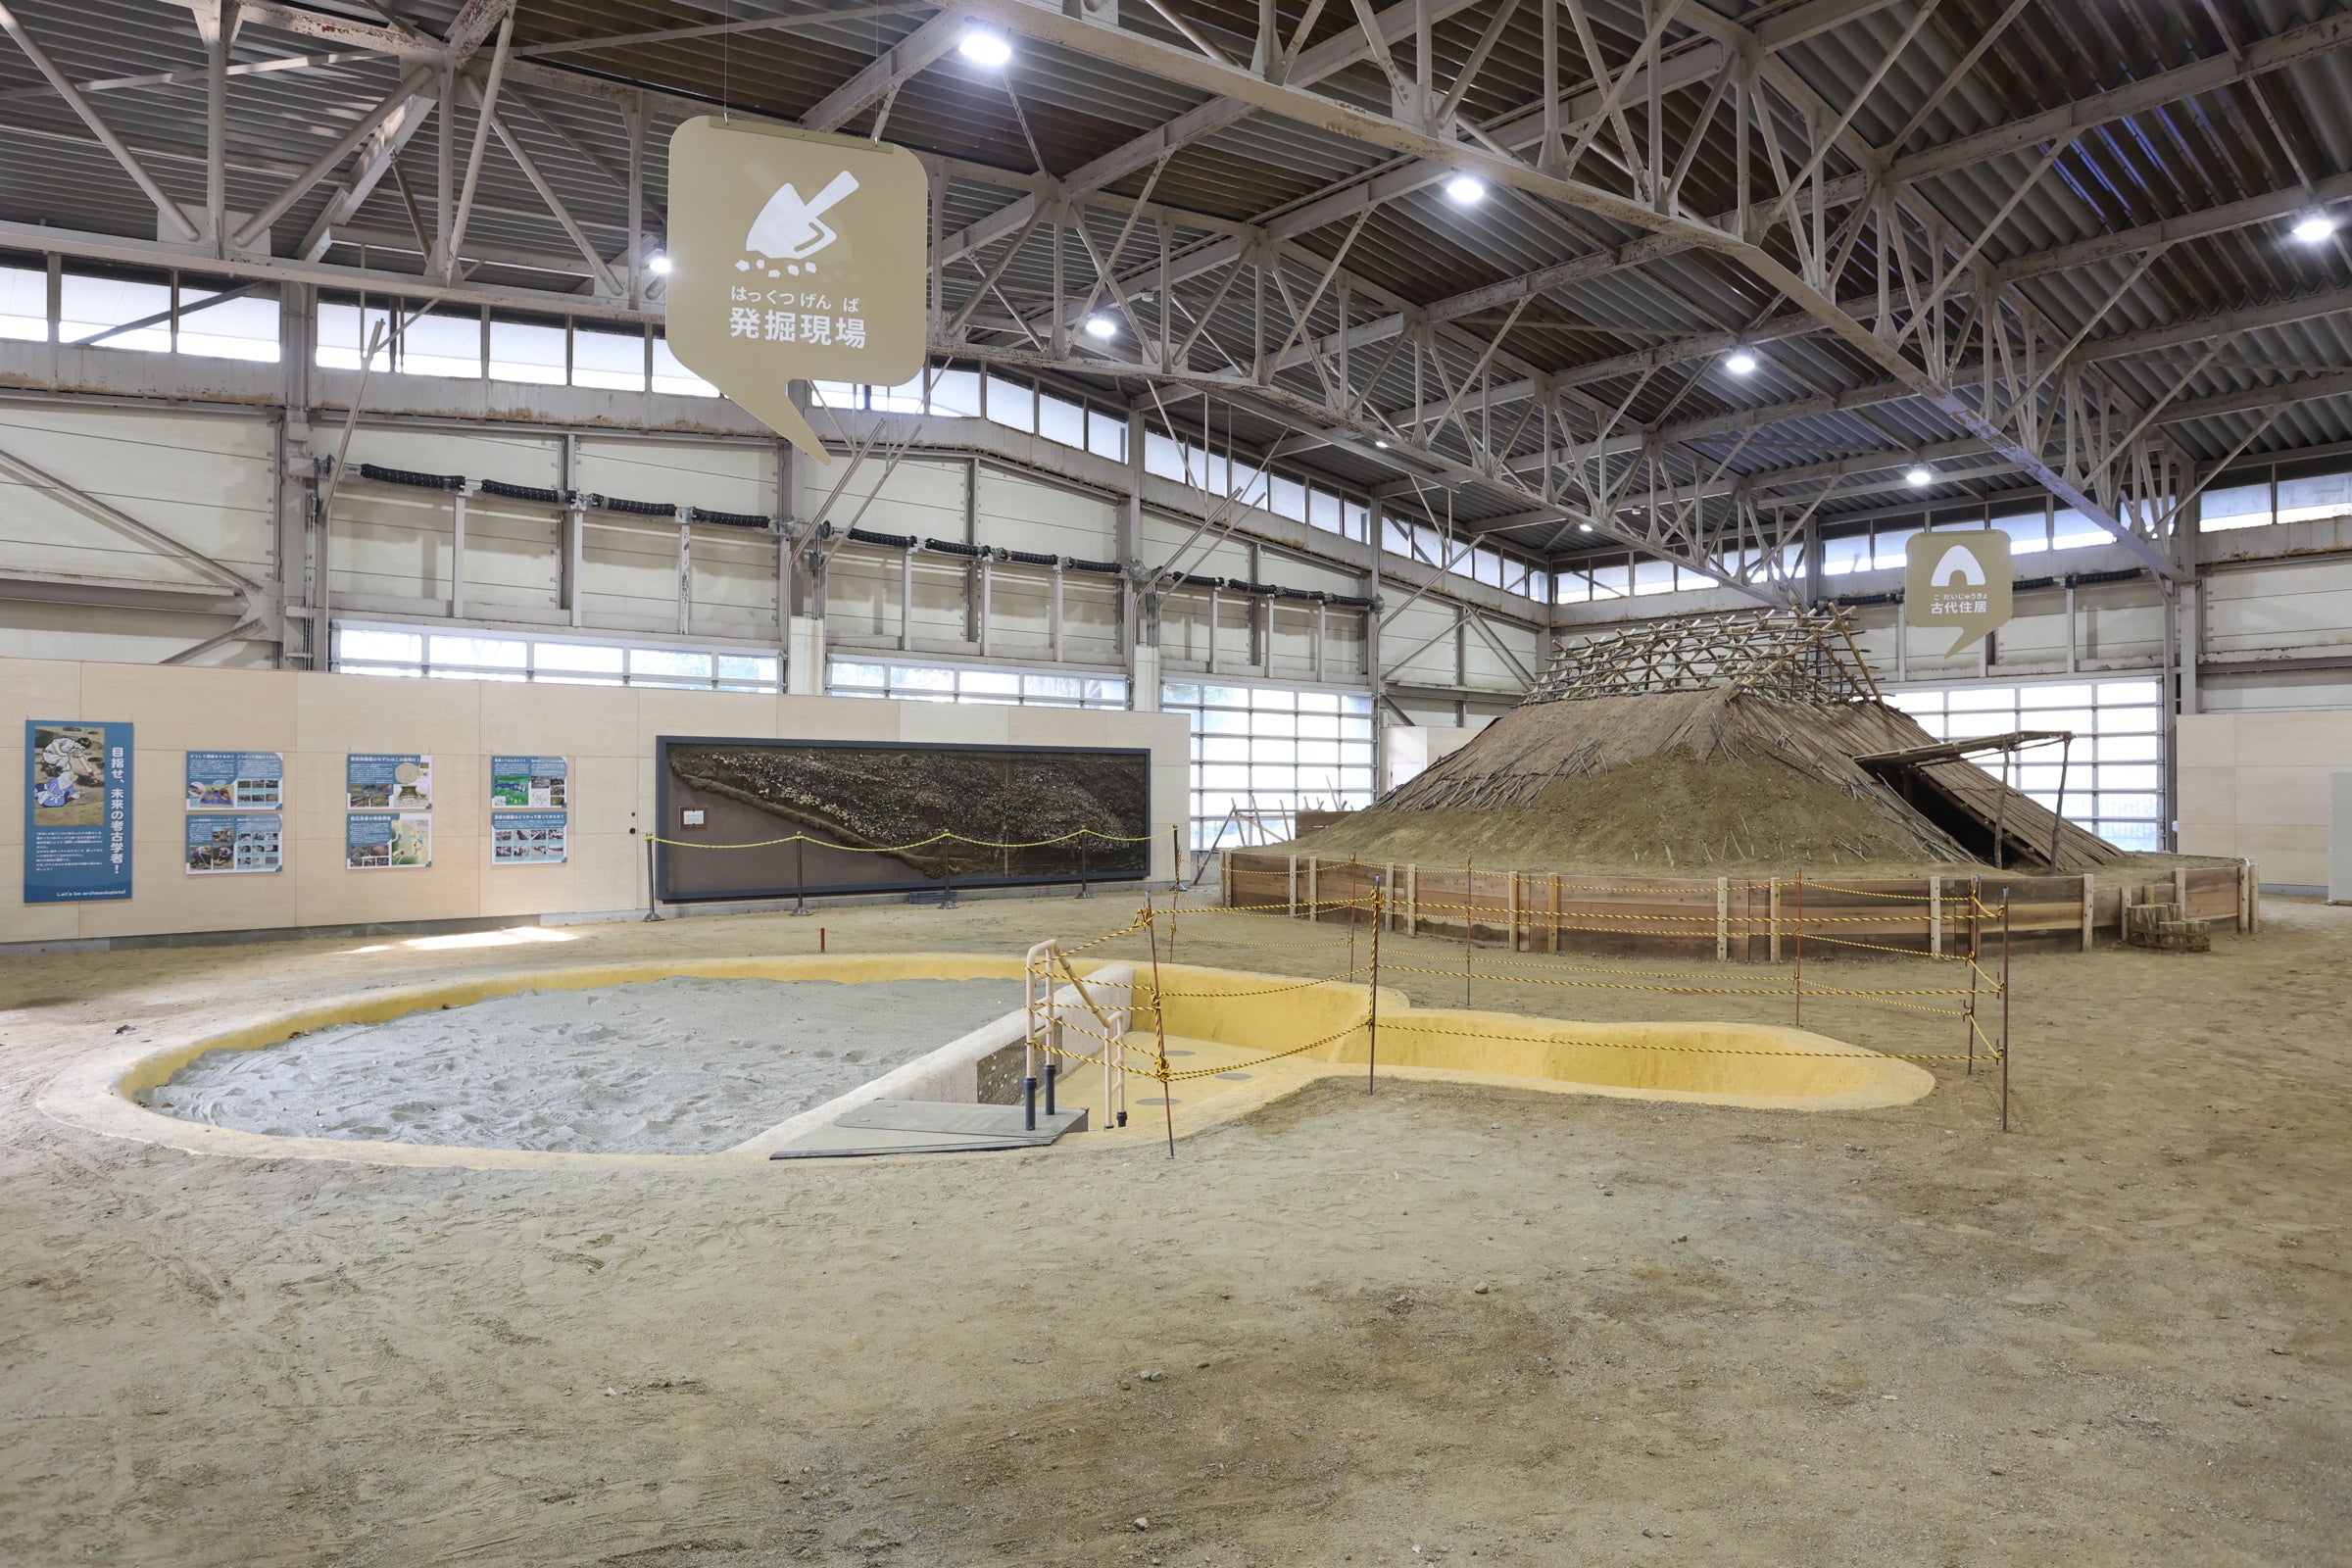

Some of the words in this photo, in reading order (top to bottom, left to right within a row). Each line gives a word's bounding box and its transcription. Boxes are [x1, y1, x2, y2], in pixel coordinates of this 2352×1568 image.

[729, 307, 867, 350] 発掘現場
[1931, 601, 1987, 614] 古代住居
